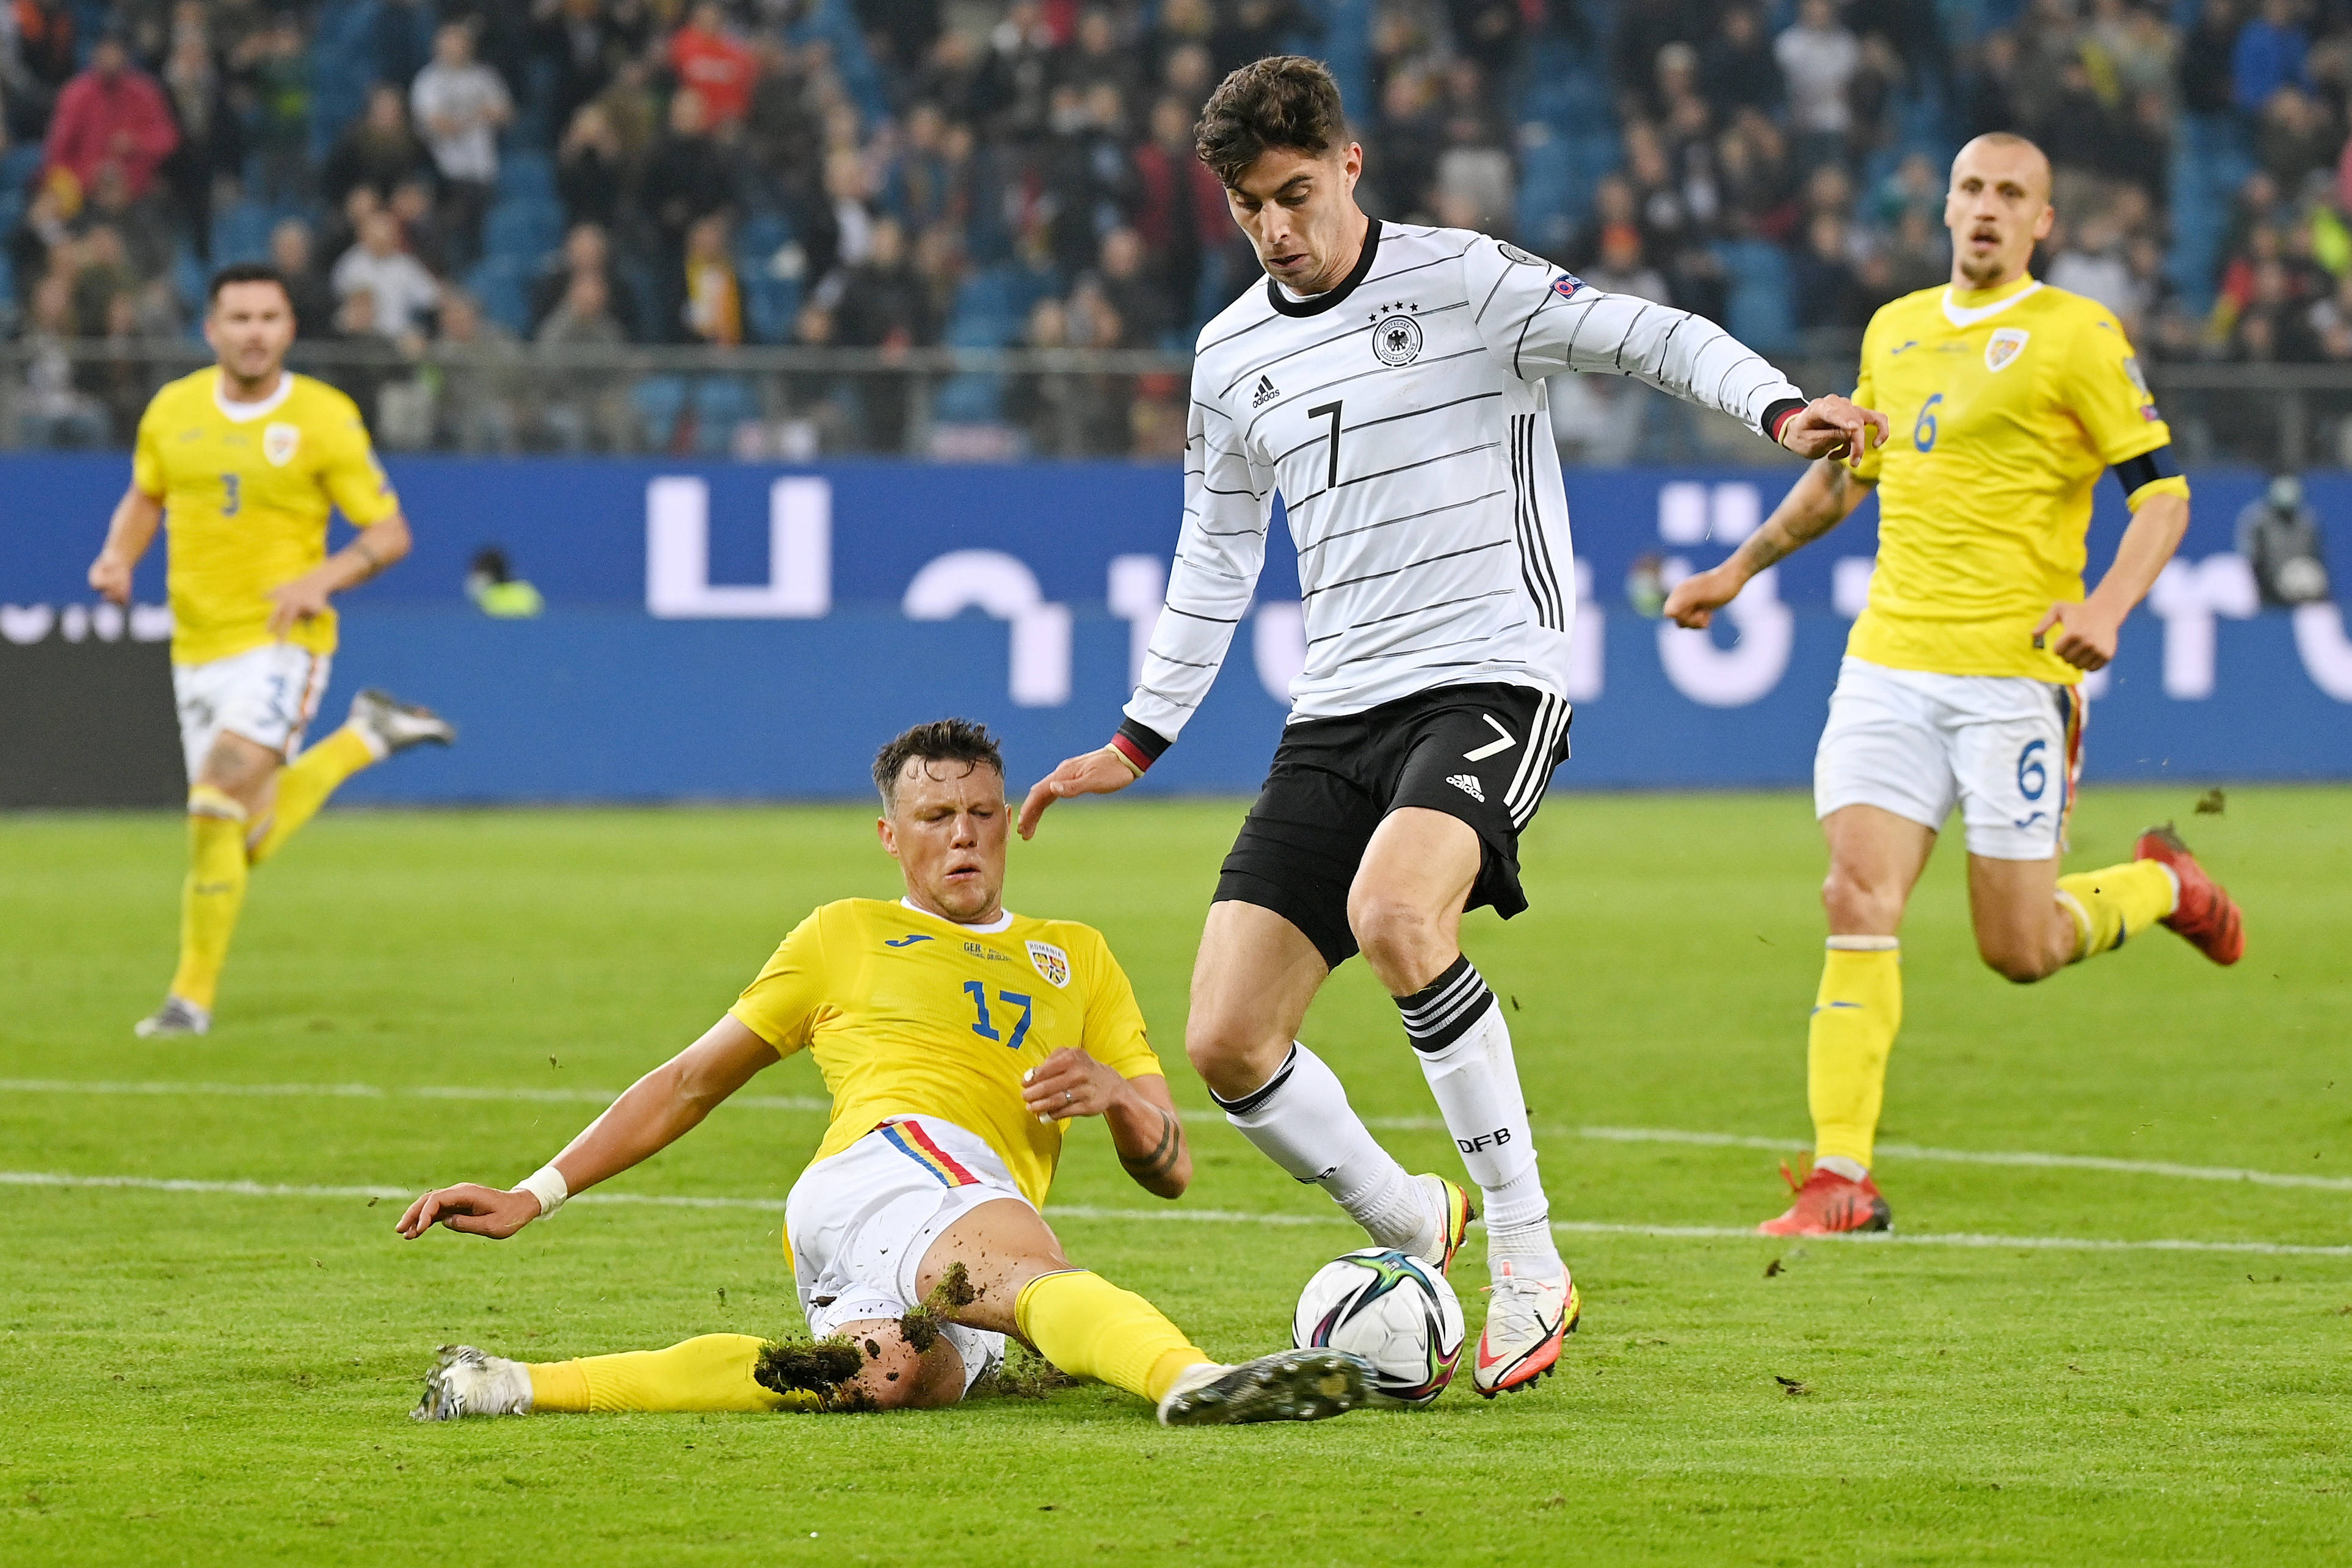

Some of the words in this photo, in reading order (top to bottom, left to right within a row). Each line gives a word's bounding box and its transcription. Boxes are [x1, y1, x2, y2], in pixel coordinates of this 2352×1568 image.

[1381, 321, 1410, 335] DEUTSCHER
[1252, 389, 1280, 408] adidas
[1307, 399, 1343, 489] 7
[1914, 393, 1943, 453] 6
[220, 473, 240, 517] 3
[1462, 713, 1517, 762] 7
[1445, 775, 1486, 803] adidas
[2017, 739, 2046, 801] 6
[964, 942, 981, 953] GER
[964, 981, 1031, 1050] 17
[1457, 1128, 1511, 1153] DFB
